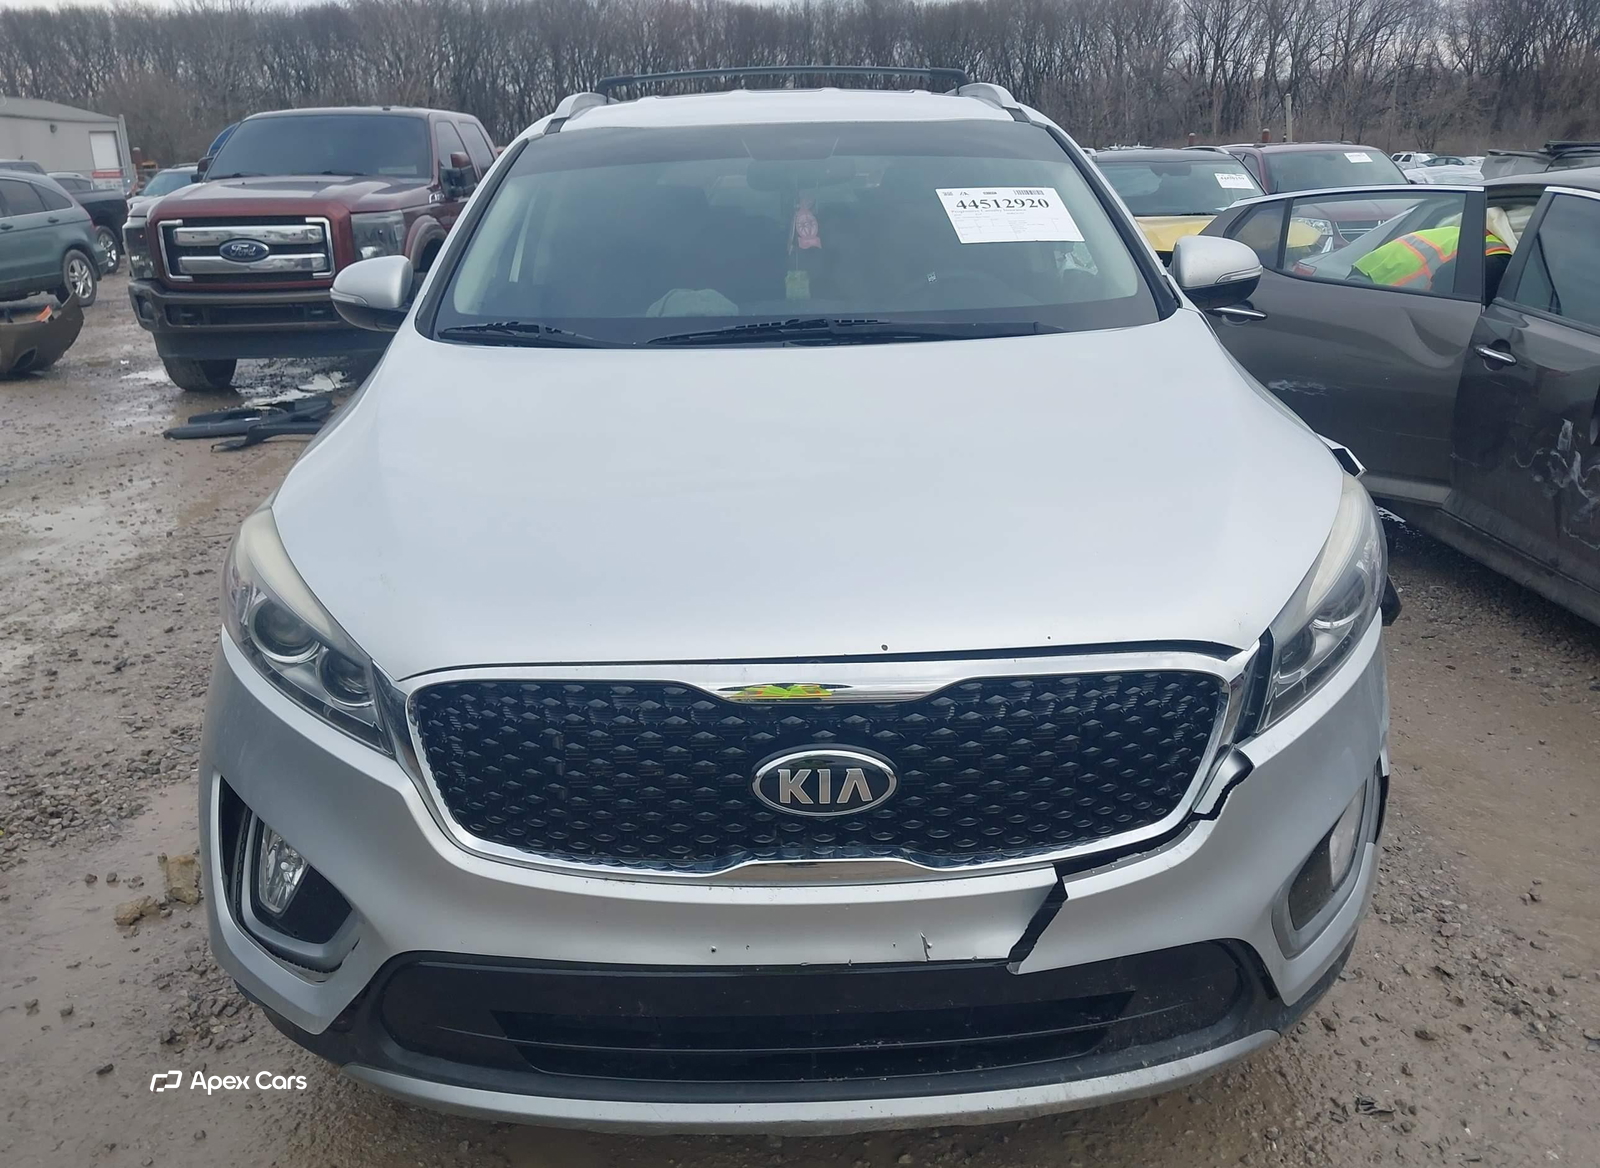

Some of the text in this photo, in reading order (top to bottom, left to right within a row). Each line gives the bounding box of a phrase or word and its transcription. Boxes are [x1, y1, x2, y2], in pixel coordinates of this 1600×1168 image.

[956, 199, 1050, 210] 44512920
[230, 244, 256, 256] Ford
[777, 768, 873, 805] KIA
